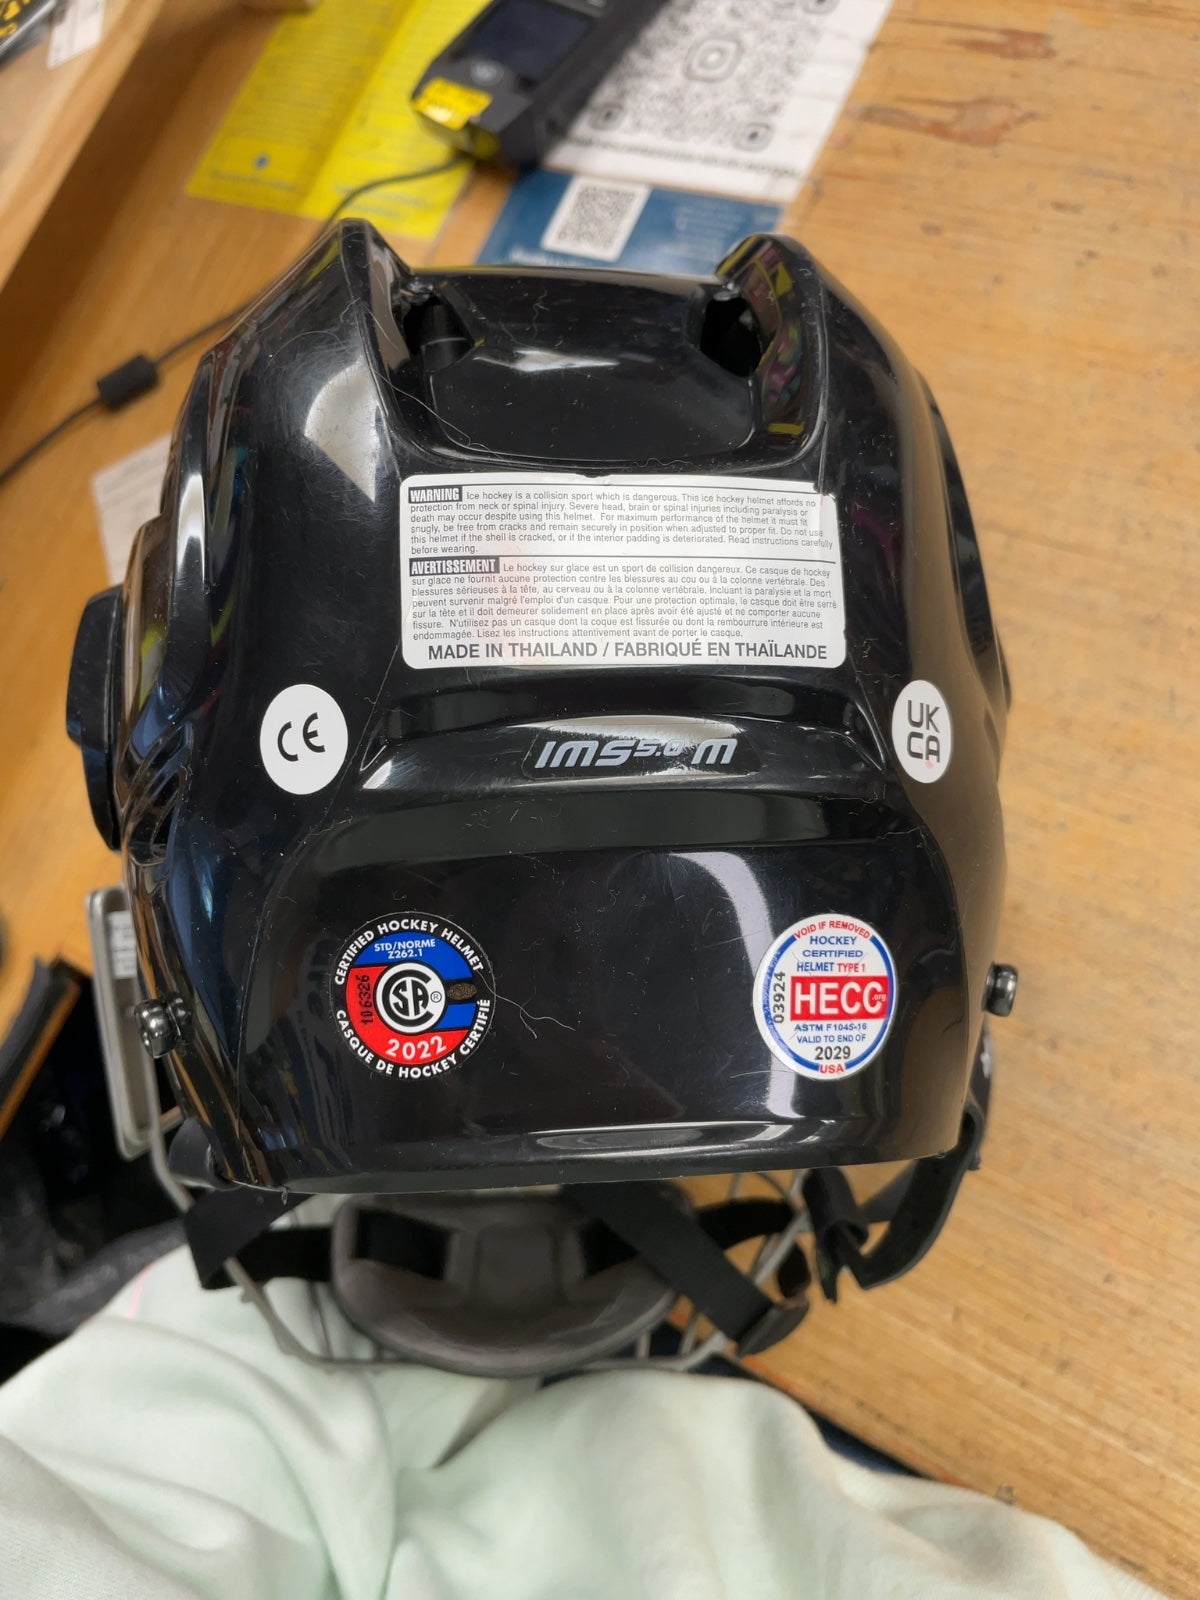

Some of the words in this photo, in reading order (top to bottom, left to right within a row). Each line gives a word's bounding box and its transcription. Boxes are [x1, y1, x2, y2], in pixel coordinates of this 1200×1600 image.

[410, 488, 459, 502] WARNING
[466, 491, 479, 499] Ice
[482, 491, 512, 501] hockey
[514, 491, 523, 499] is
[533, 491, 568, 499] collision
[570, 491, 593, 501] sport
[595, 491, 620, 500] which
[622, 491, 630, 500] is
[632, 492, 679, 503] dangerous.
[681, 493, 699, 502] This
[701, 493, 713, 502] ice
[715, 494, 745, 505] hockey
[746, 495, 774, 505] helmet
[776, 496, 803, 506] affords
[805, 499, 816, 507] no
[410, 502, 453, 513] protection
[455, 502, 475, 510] from
[478, 501, 499, 510] neck
[512, 501, 538, 511] spinal
[541, 501, 566, 511] injury.
[569, 501, 599, 510] Severe
[601, 501, 625, 511] head,
[628, 502, 649, 510] brain
[663, 502, 688, 513] spinal
[690, 503, 721, 514] injuries
[722, 504, 760, 516] including
[762, 506, 798, 517] paralysis
[410, 513, 434, 522] death
[437, 514, 455, 523] may
[457, 513, 484, 521] occur
[484, 512, 517, 522] despite
[517, 512, 542, 522] using
[545, 512, 560, 520] this
[563, 512, 594, 520] helmet.
[600, 512, 614, 520] For
[616, 512, 657, 521] maximum
[660, 513, 713, 524] performance
[715, 514, 723, 523] of
[725, 514, 739, 523] the
[741, 515, 769, 524] helmet
[769, 516, 777, 524] it
[778, 516, 798, 525] must
[799, 517, 807, 526] fit
[410, 523, 440, 534] snugly,
[442, 523, 454, 531] be
[456, 523, 474, 531] free
[476, 522, 496, 531] from
[498, 522, 527, 531] cracks
[529, 522, 546, 530] and
[548, 522, 578, 530] remain
[580, 522, 617, 533] securely
[619, 522, 627, 531] in
[629, 523, 663, 533] position
[665, 523, 688, 532] when
[690, 524, 726, 535] adjusted
[728, 525, 737, 533] to
[739, 526, 766, 536] proper
[767, 526, 779, 535] fit.
[779, 526, 792, 535] Do
[794, 527, 808, 536] not
[808, 529, 824, 537] use
[410, 534, 426, 542] this
[428, 533, 458, 542] helmet
[459, 533, 466, 542] if
[467, 533, 482, 542] the
[485, 533, 506, 541] shell
[508, 533, 516, 541] is
[518, 533, 555, 542] cracked,
[569, 533, 574, 541] if
[577, 533, 591, 541] the
[593, 533, 623, 541] interior
[626, 533, 660, 543] padding
[662, 533, 670, 542] is
[672, 533, 726, 543] deteriorated.
[728, 535, 750, 544] Read
[751, 535, 799, 546] instructions
[799, 537, 832, 549] carefully
[410, 545, 438, 553] before
[440, 544, 478, 555] wearing.
[411, 559, 495, 574] AVERTISSEMENT
[503, 563, 514, 571] Le
[516, 563, 547, 573] hockey
[566, 563, 589, 573] glace
[592, 563, 605, 571] est
[621, 563, 643, 574] sport
[645, 563, 656, 572] de
[659, 564, 693, 572] collision
[696, 564, 743, 575] dangereux.
[744, 565, 757, 574] Ce
[759, 567, 790, 577] casque
[790, 566, 801, 575] de
[803, 567, 830, 578] hockey
[412, 629, 474, 642] endommagée.
[476, 628, 500, 637] Lisez
[502, 628, 516, 637] les
[518, 628, 569, 636] instructions
[571, 628, 630, 636] attentivement
[632, 628, 656, 636] avant
[658, 628, 669, 636] de
[429, 645, 480, 660] MADE
[486, 644, 503, 657] IN
[509, 642, 597, 656] THAILAND
[615, 639, 701, 657] FABRIQUÉ
[708, 642, 729, 656] EN
[736, 640, 827, 659] THAÏLANDE
[907, 699, 939, 732] UK
[277, 711, 326, 761] CE
[691, 738, 738, 765] M
[907, 732, 940, 763] CA
[795, 924, 816, 939] VOID
[829, 920, 871, 939] REMOVED
[374, 939, 435, 952] STD/NORME
[810, 936, 858, 945] HOCKEY
[335, 930, 374, 985] CERTIFIED
[377, 919, 439, 934] HOCKEY
[441, 928, 484, 972] HELMET
[388, 949, 423, 959] Z262.1
[802, 950, 863, 958] CERTIFIED
[797, 962, 835, 972] HELMET
[837, 963, 860, 972] TYPE
[862, 963, 866, 972] 1
[773, 971, 785, 1023] 03924
[794, 1024, 823, 1032] ASTM
[336, 1010, 374, 1063] CASQUE
[376, 1059, 393, 1075] DE
[398, 1056, 457, 1078] HOCKEY
[460, 998, 490, 1055] CERTIFIÉ
[855, 1034, 866, 1042] OF
[385, 1036, 447, 1059] 2022
[815, 1046, 851, 1061] 2029
[820, 1064, 844, 1074] USA
